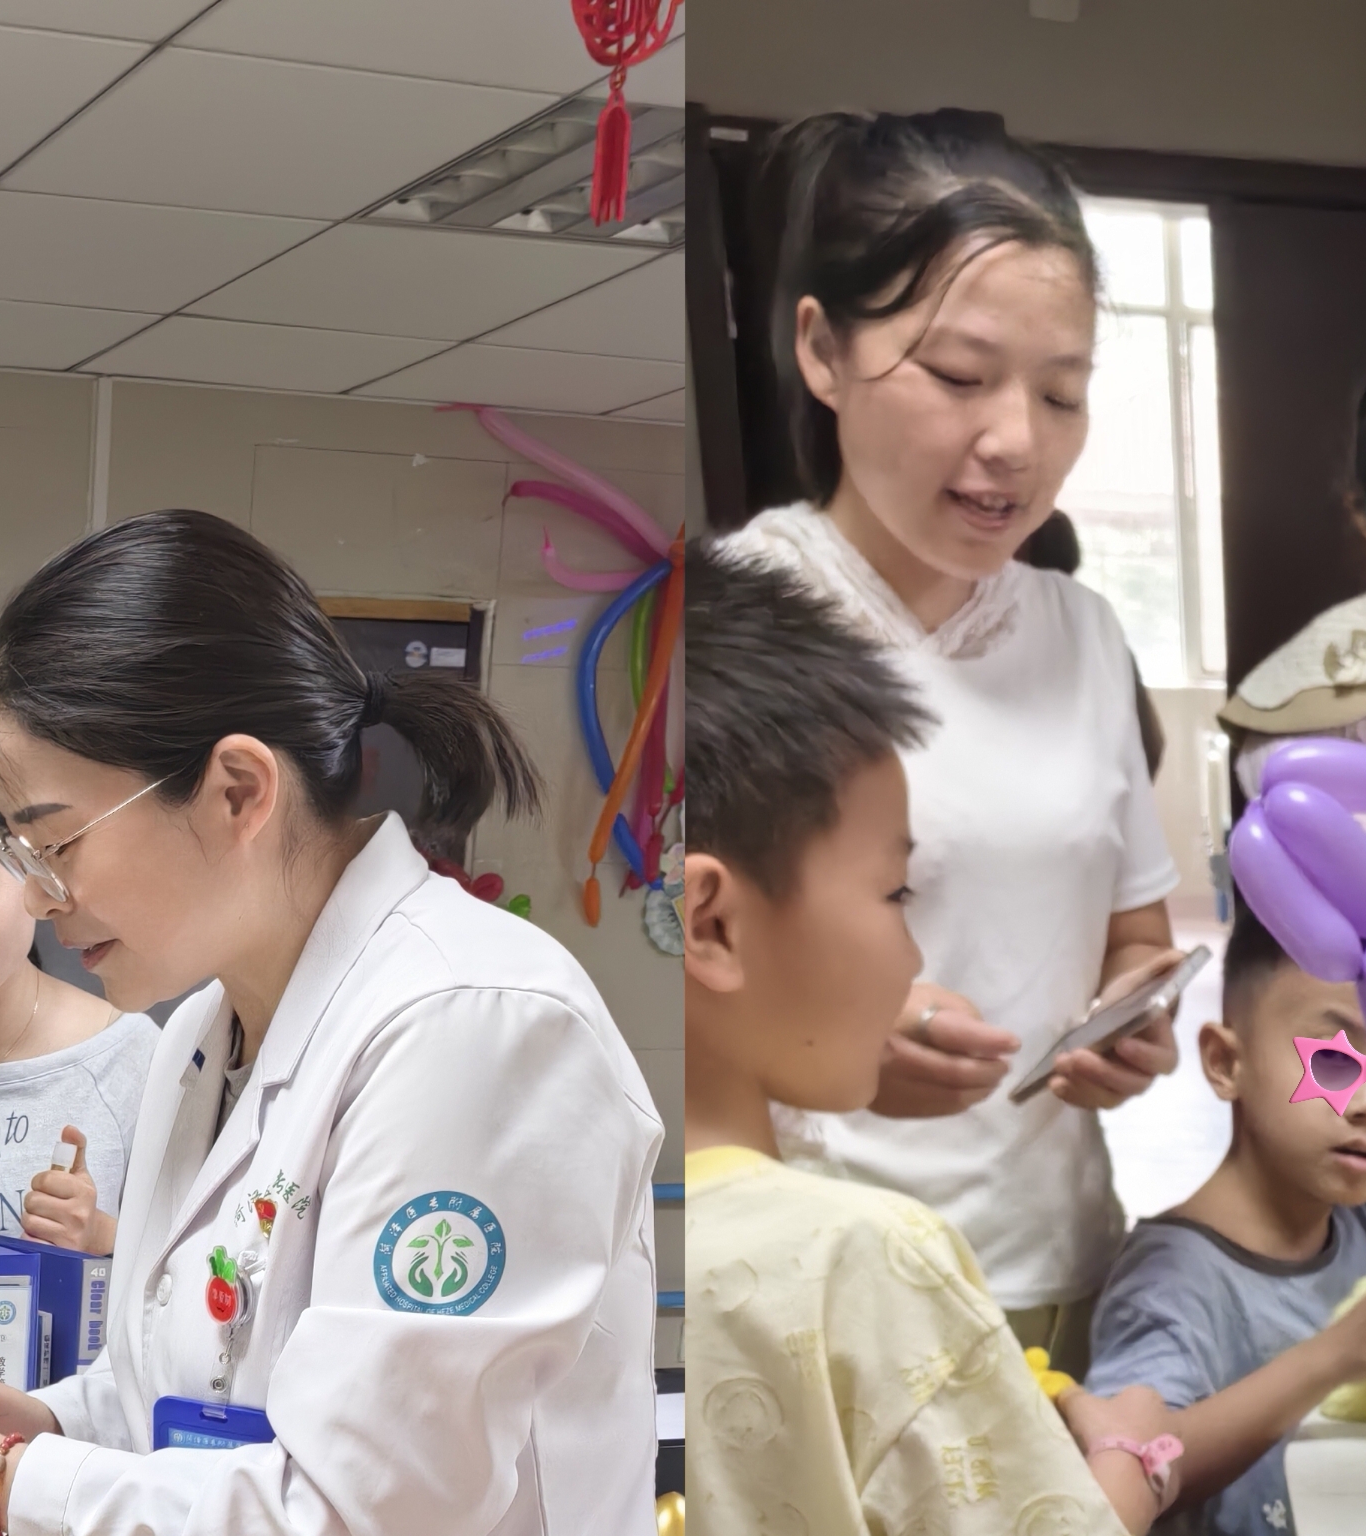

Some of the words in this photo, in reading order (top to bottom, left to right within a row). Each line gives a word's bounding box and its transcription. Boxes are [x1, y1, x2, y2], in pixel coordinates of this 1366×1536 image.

[4, 1111, 30, 1146] to
[455, 1293, 481, 1312] MEDICAL
[478, 1265, 498, 1293] COLLEGE
